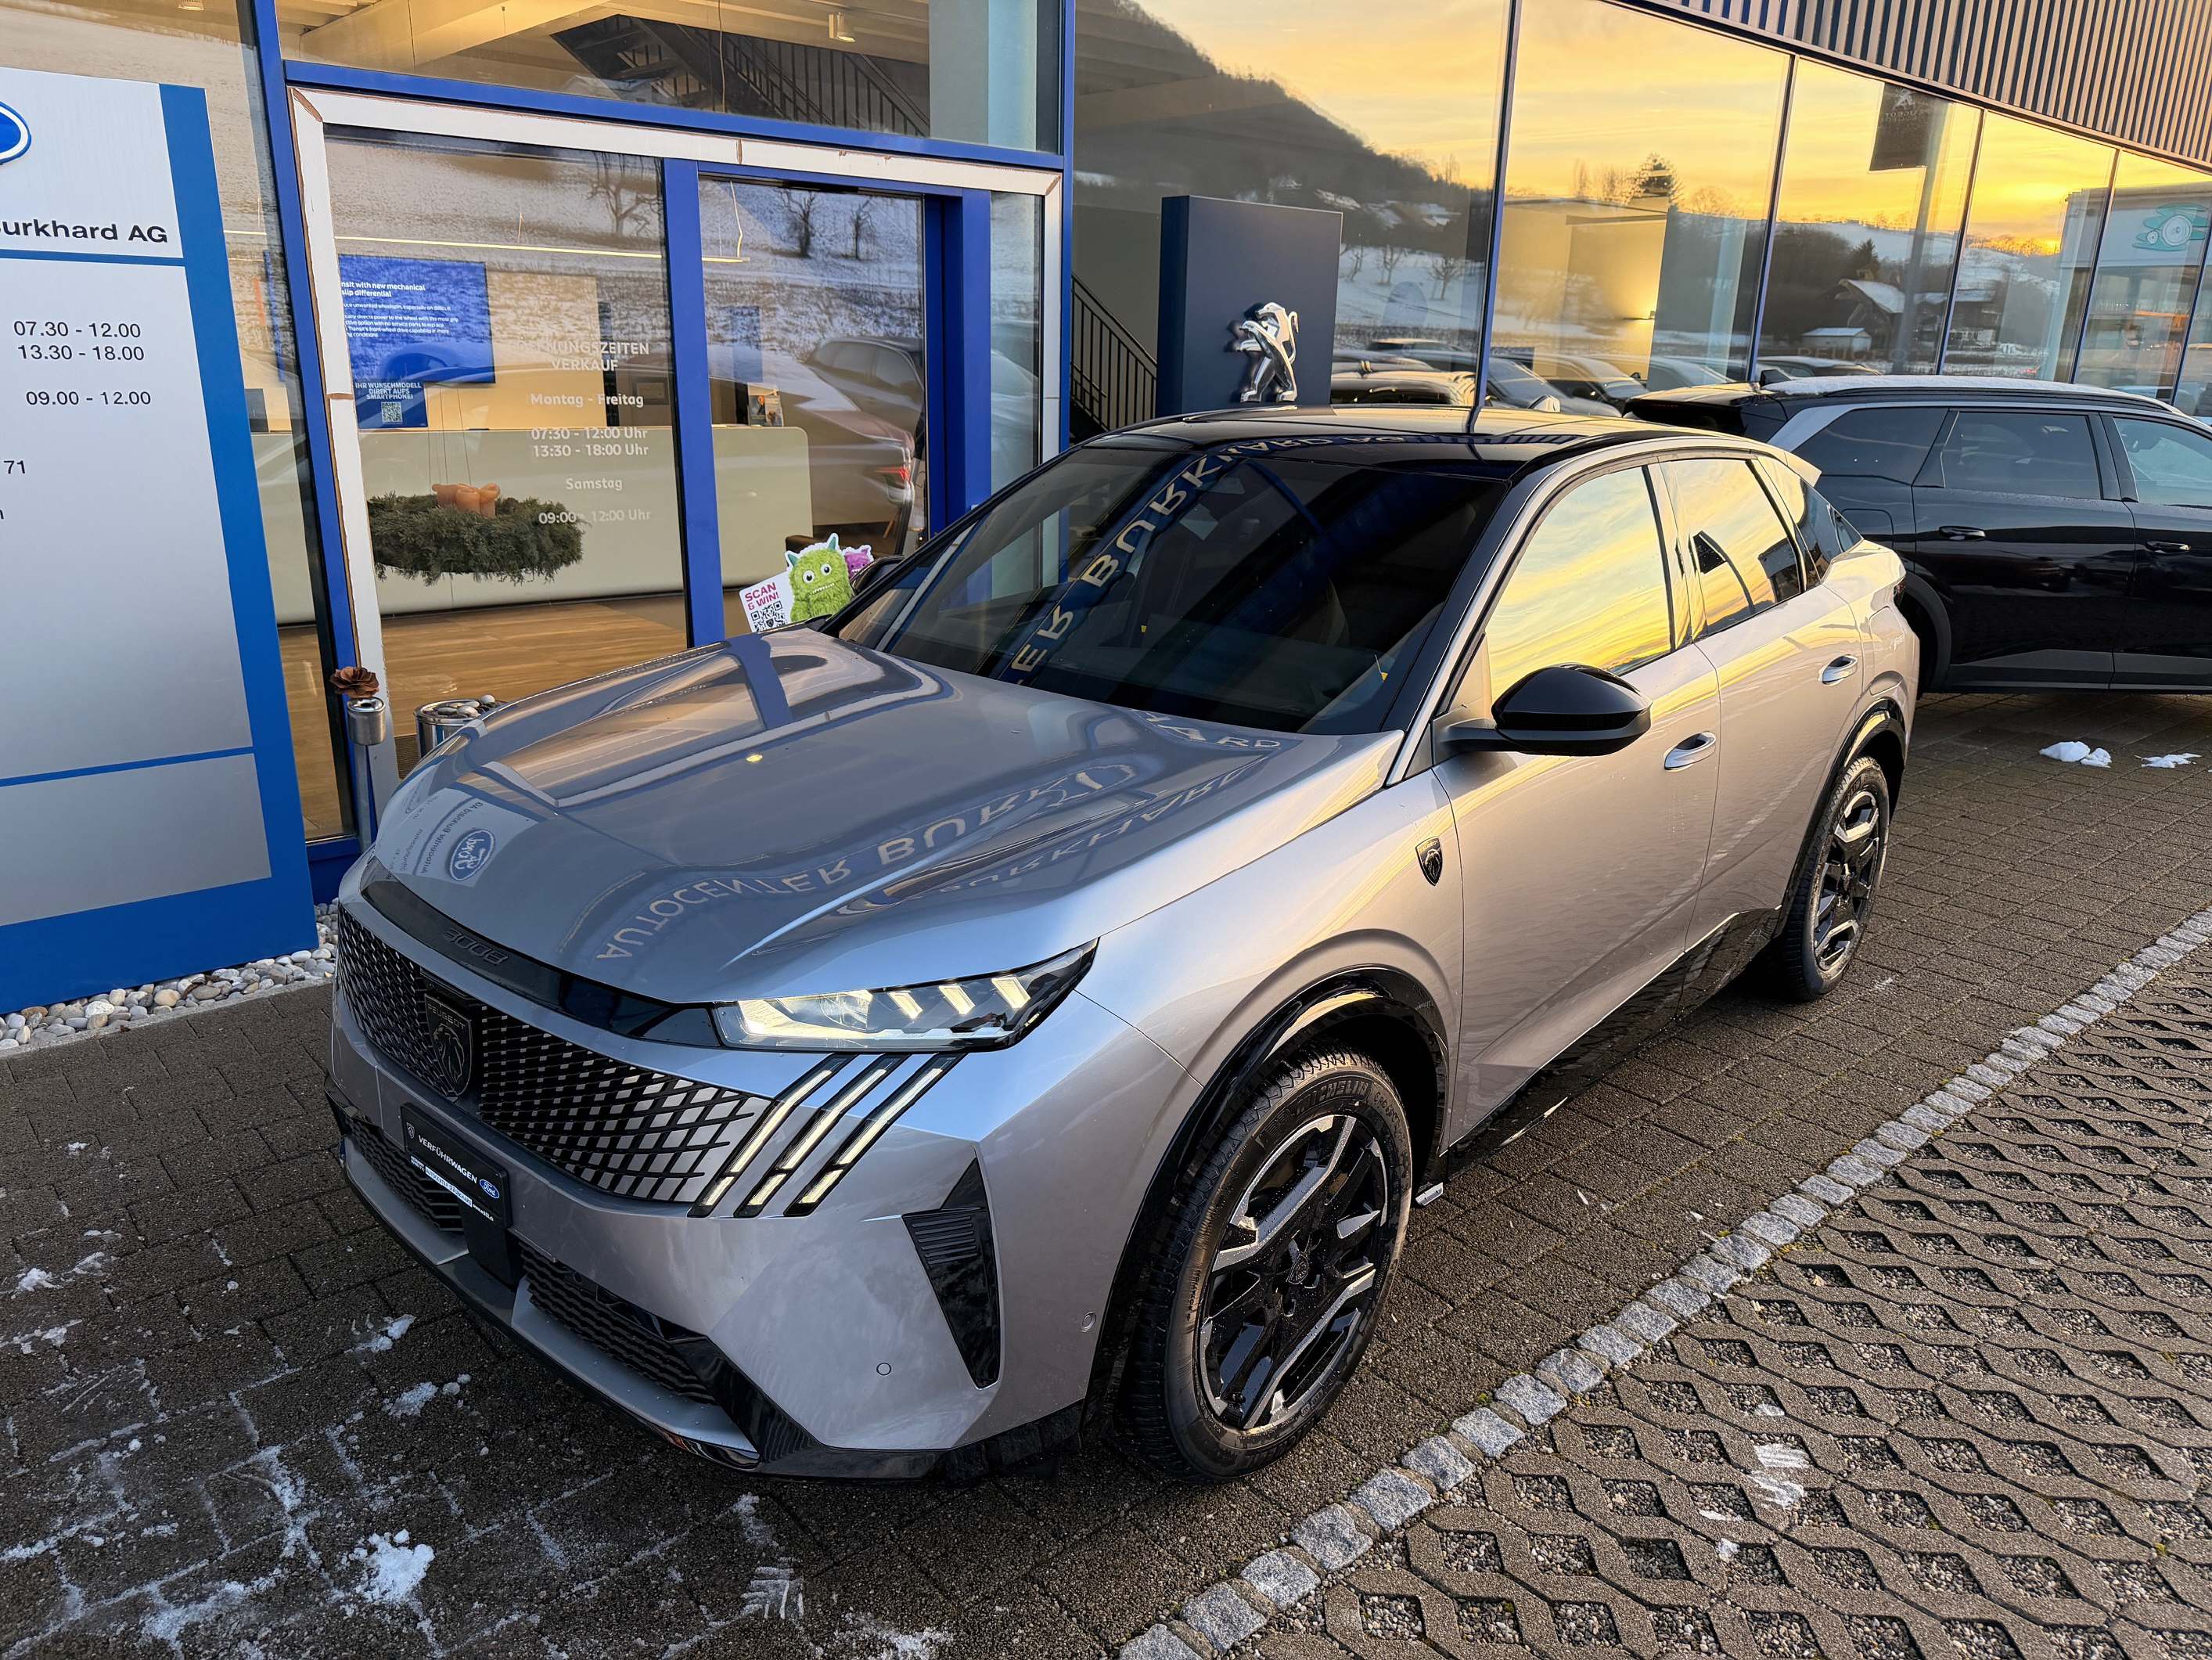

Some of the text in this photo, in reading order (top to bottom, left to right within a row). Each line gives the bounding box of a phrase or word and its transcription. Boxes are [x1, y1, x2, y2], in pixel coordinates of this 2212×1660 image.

[0, 219, 168, 243] urkhard AG
[13, 320, 69, 337] 07.30
[88, 322, 142, 338] 12.00
[17, 344, 73, 360] 13.30
[92, 345, 145, 361] 18.00
[551, 358, 619, 372] VERKAUF
[26, 391, 80, 405] 09.00
[99, 391, 152, 405] 12.00
[531, 394, 584, 408] Montag
[598, 394, 644, 408] Freitag
[531, 428, 570, 440] 07:30
[585, 427, 620, 439] 12:00
[624, 426, 648, 439] Uhr
[534, 445, 571, 458] 13:30
[585, 444, 622, 456] 18:00
[625, 443, 649, 456] Uhr
[566, 477, 623, 492] Samstag
[538, 511, 577, 524] 09:00
[591, 510, 624, 523] 12:00
[628, 509, 652, 521] Uhr
[744, 582, 777, 602] SCAN
[757, 591, 779, 607] WIN!
[427, 1003, 466, 1030] PEUGEOT
[418, 1134, 478, 1184] VERFÜHRWAGEN
